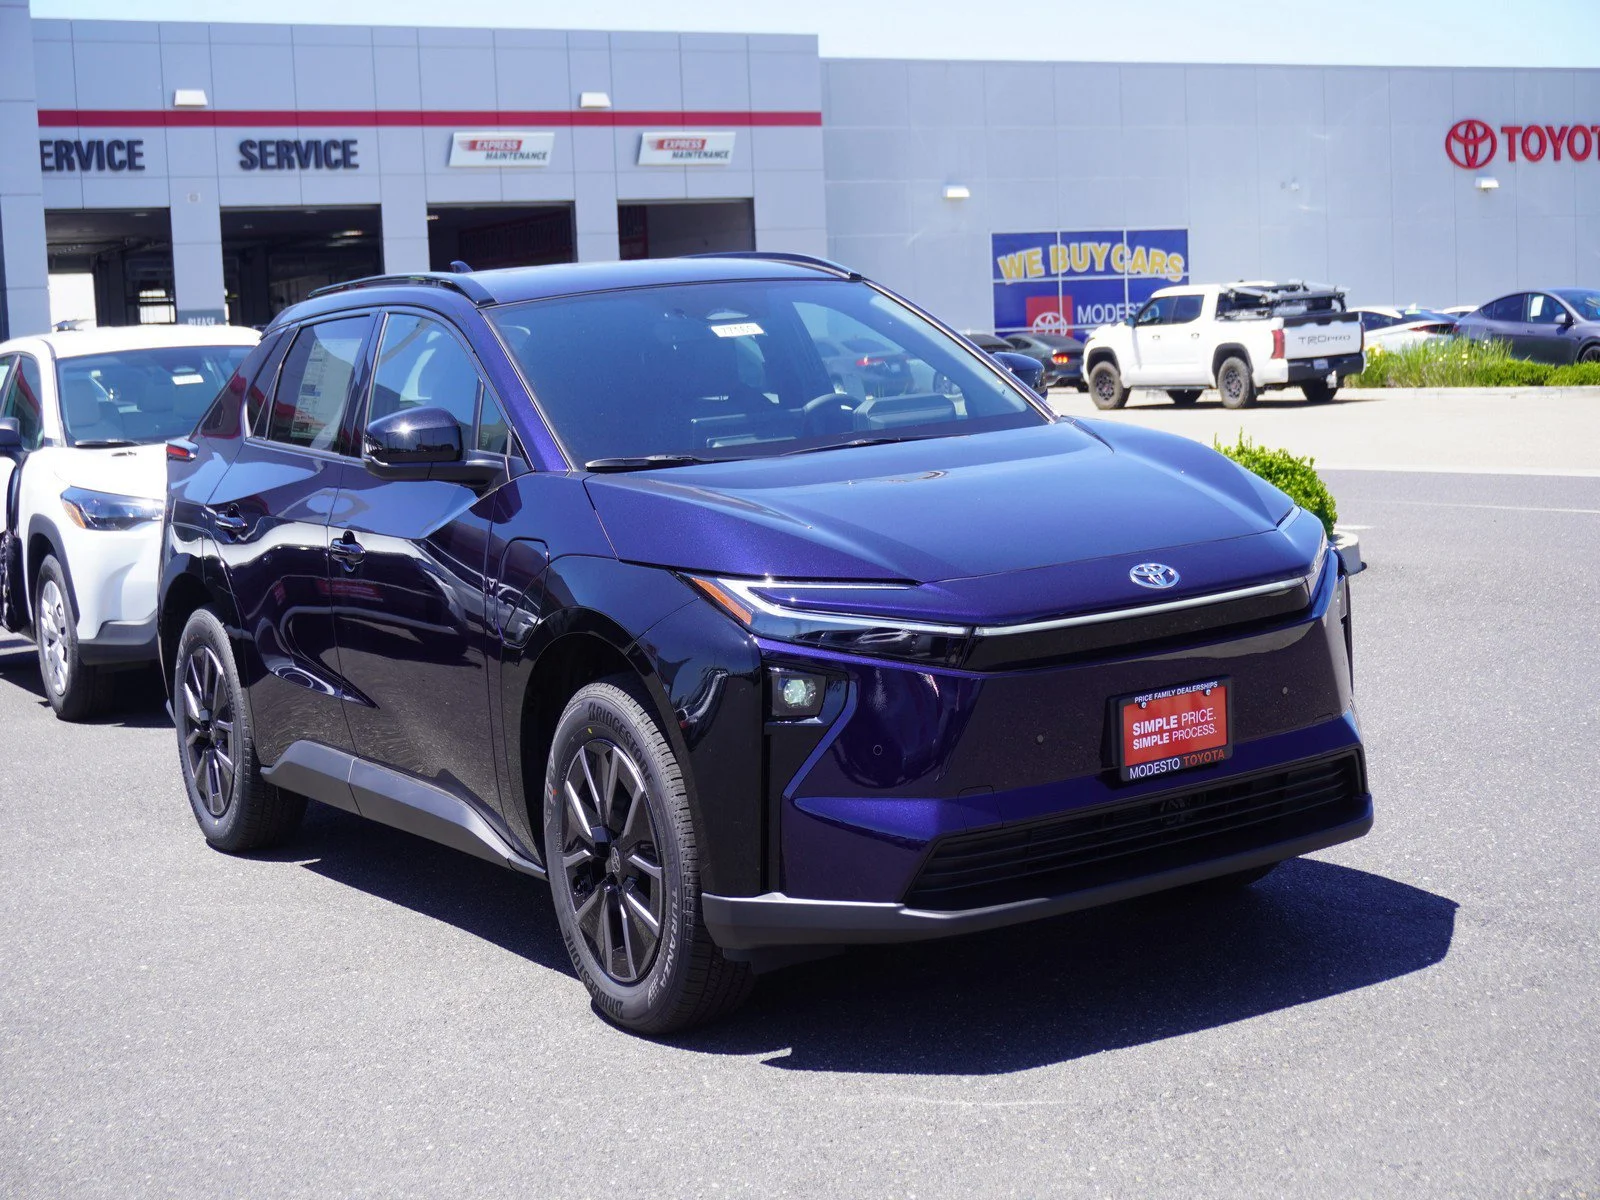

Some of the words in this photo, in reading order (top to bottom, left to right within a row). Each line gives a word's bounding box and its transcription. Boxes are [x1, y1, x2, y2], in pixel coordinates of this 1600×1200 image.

[39, 139, 145, 171] ERVICE
[239, 139, 360, 170] SERVICE
[485, 151, 548, 161] MAINTENANCE
[671, 150, 730, 160] MAINTENANCE
[997, 247, 1045, 285] WE
[1049, 242, 1111, 275] BUY
[1110, 243, 1185, 283] CARS
[1134, 693, 1153, 704] PRICE
[1154, 689, 1176, 700] FAMILY
[1176, 681, 1218, 696] DEALERSHIPS
[1132, 715, 1178, 736] SIMPLE
[1181, 707, 1217, 727] PRICE.
[1132, 732, 1170, 750] SIMPLE
[1172, 723, 1217, 742] PROCESS.
[588, 702, 655, 785] BRIDGESTONE
[1129, 757, 1181, 780] MODESTO
[1183, 748, 1225, 767] TOYOTA
[659, 886, 679, 988] TURANZA
